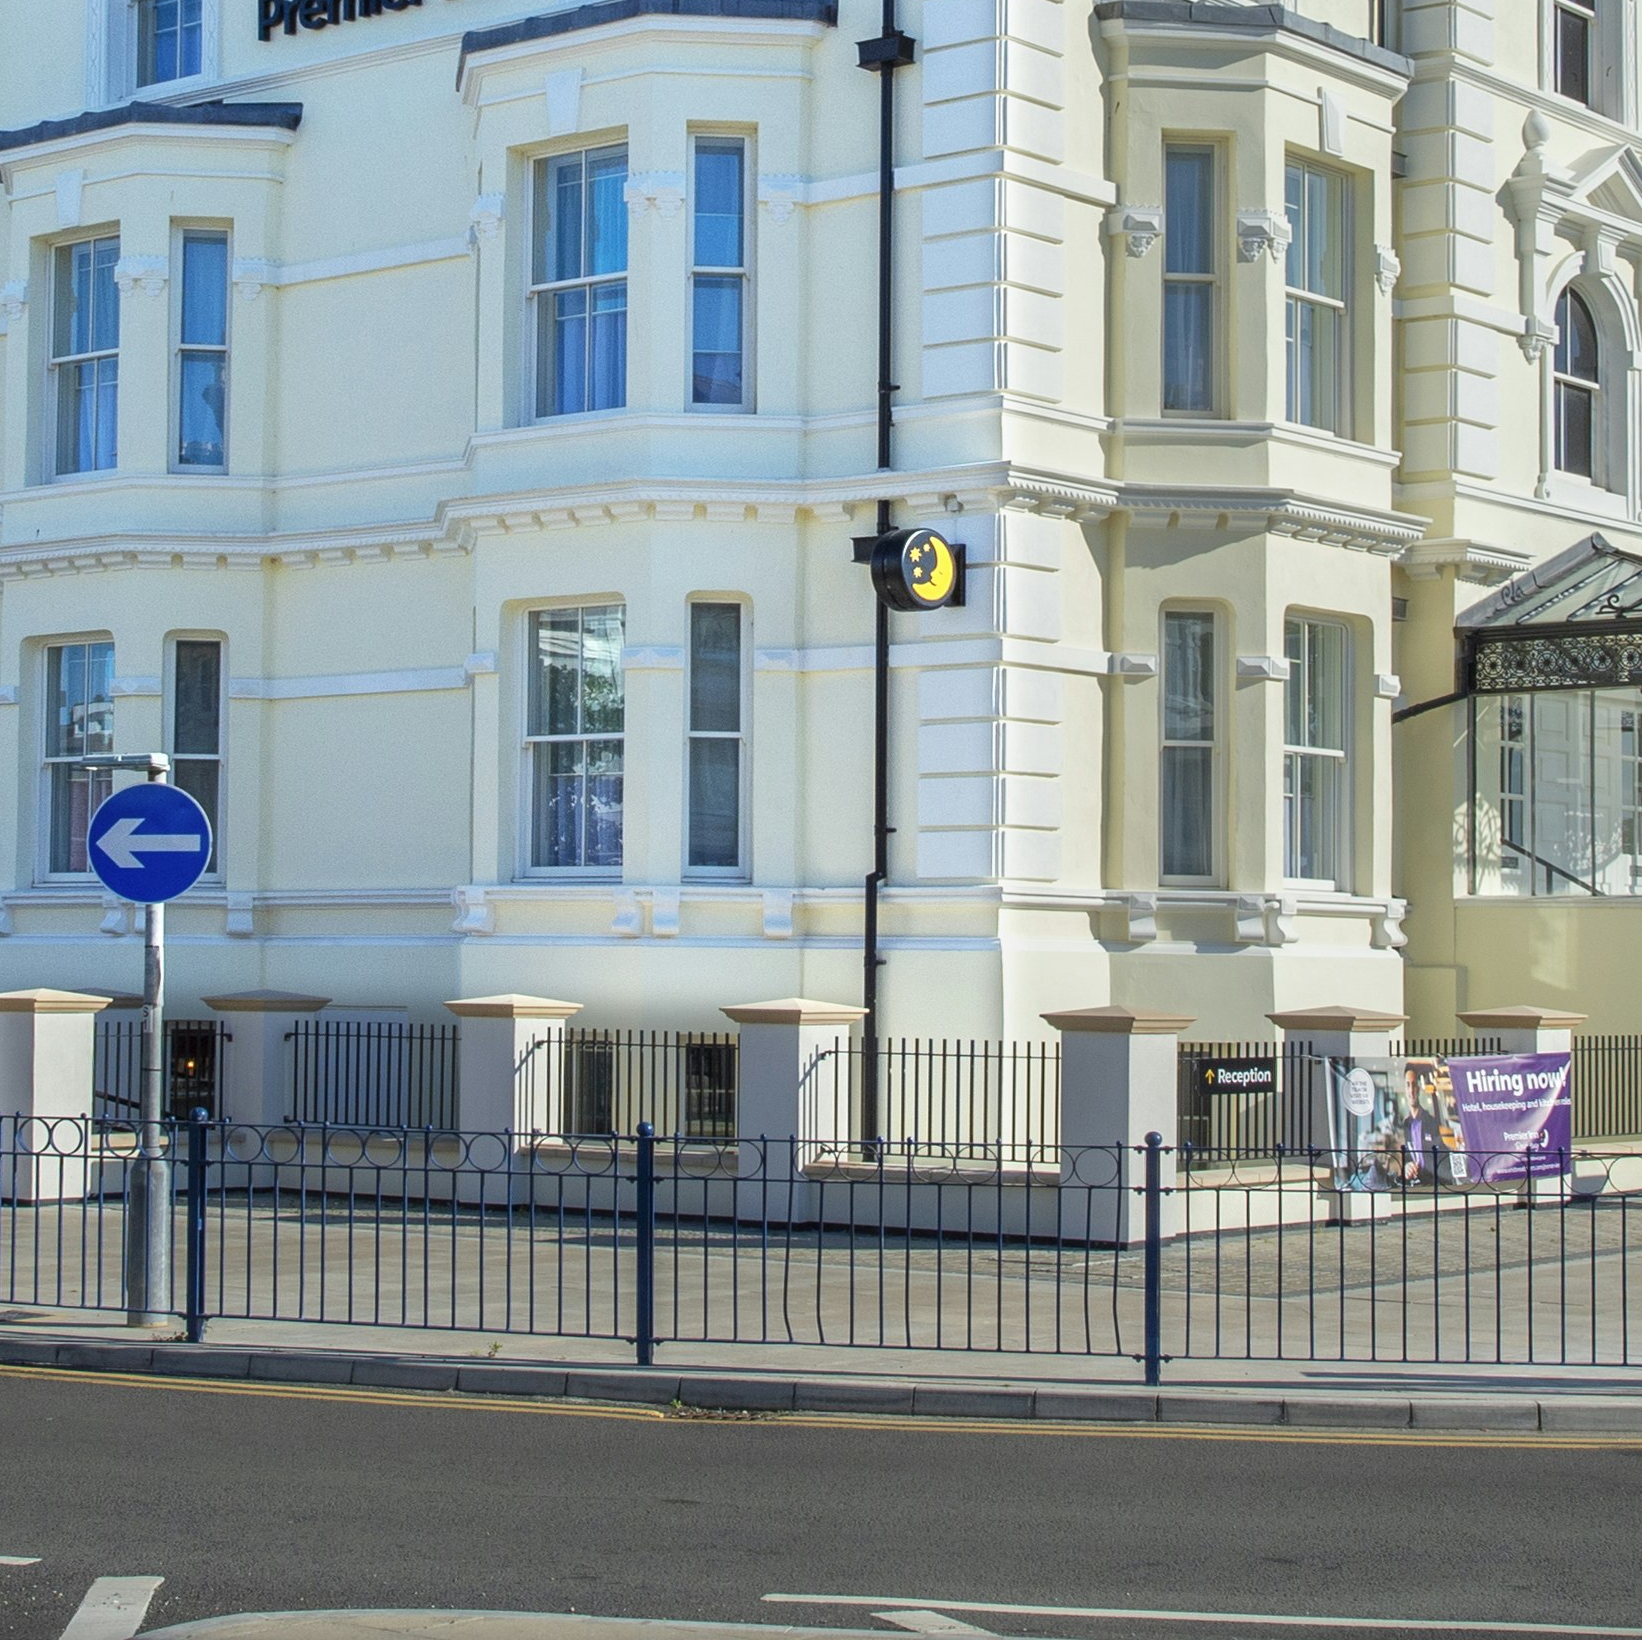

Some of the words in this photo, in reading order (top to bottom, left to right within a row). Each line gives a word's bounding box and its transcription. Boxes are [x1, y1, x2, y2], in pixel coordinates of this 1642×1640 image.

[1217, 1067, 1272, 1087] Reception
[1466, 1069, 1523, 1096] Hiring
[1526, 1067, 1566, 1090] now!
[1462, 1103, 1482, 1113] Hotel,
[1482, 1100, 1526, 1112] housekeeping
[1527, 1099, 1538, 1108] and
[1503, 1131, 1527, 1141] Premier
